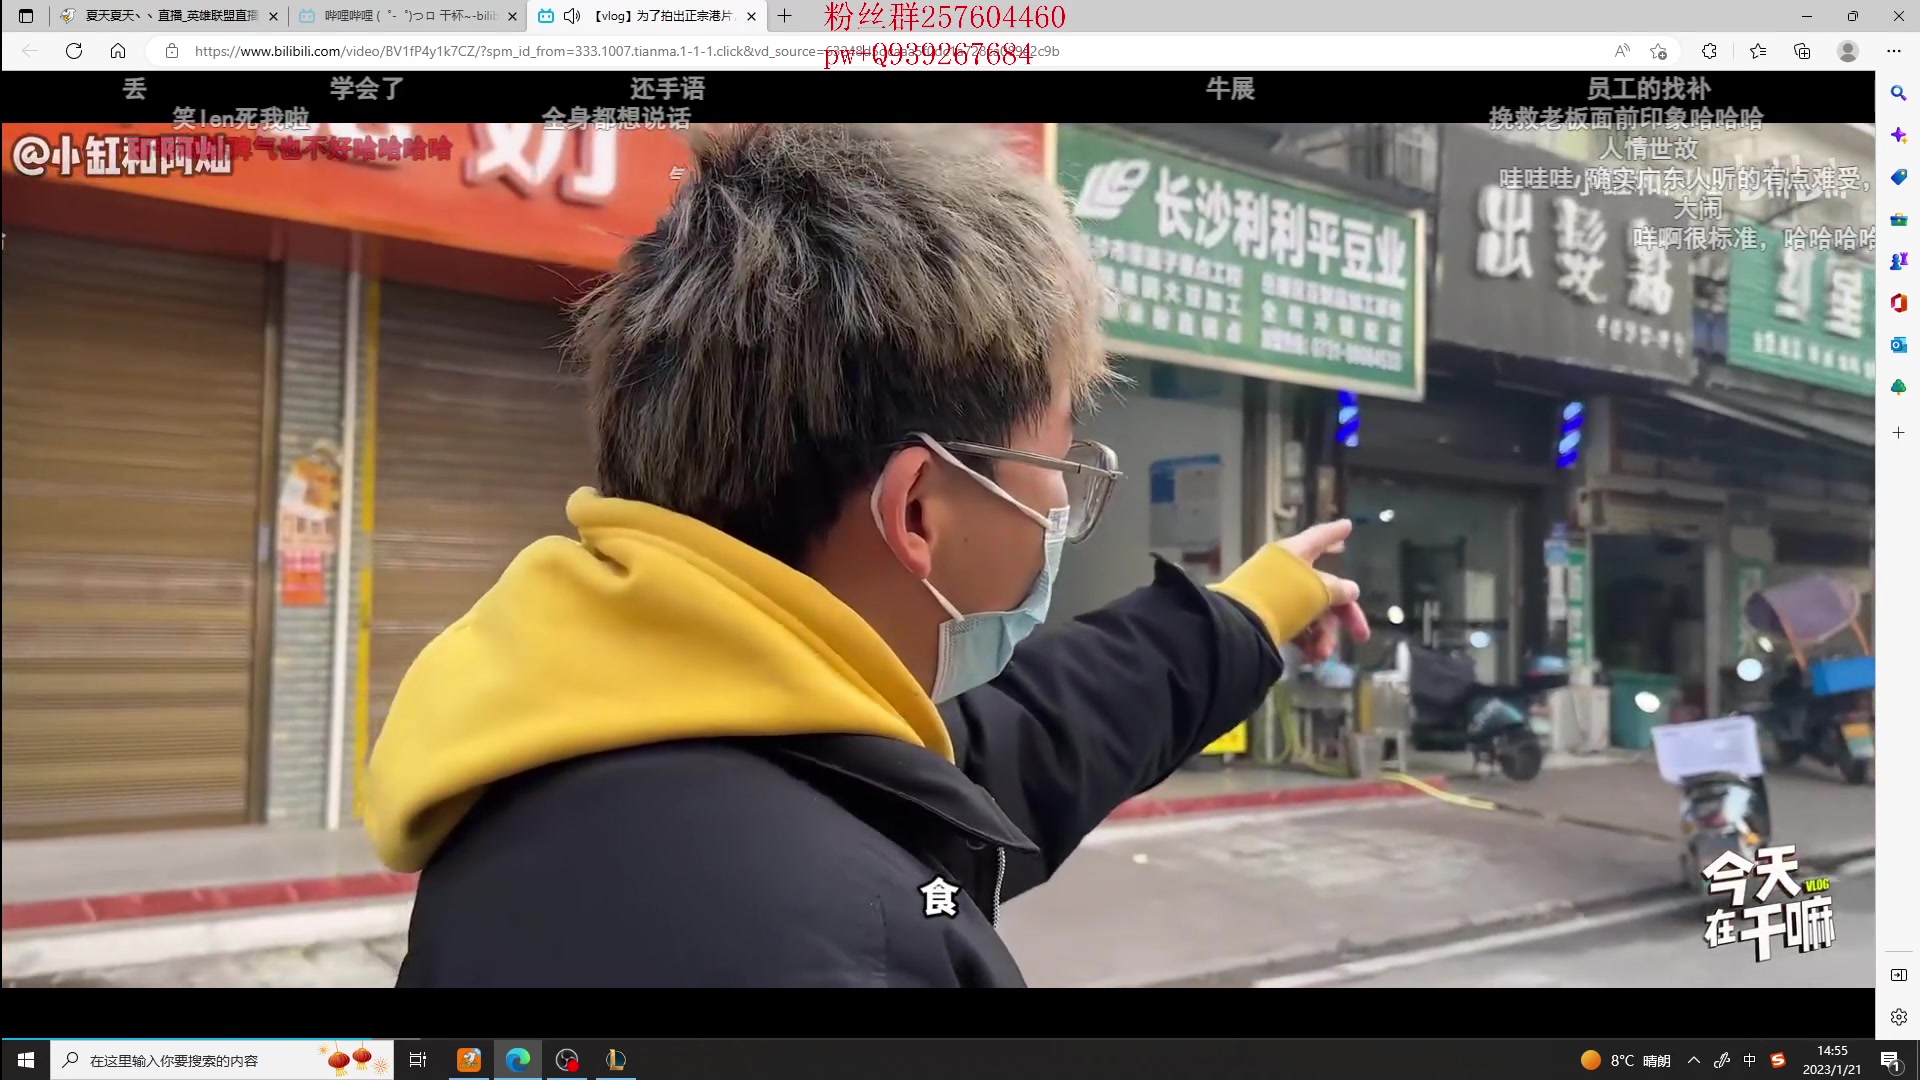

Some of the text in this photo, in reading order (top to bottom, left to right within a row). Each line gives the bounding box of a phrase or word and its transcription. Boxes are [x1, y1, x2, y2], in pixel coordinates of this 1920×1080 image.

[325, 9, 374, 22] 哔哩哔哩
[1154, 165, 1407, 290] 长沙利利平豆业
[1817, 1045, 1849, 1056] 14:55
[90, 1054, 259, 1068] 在这里输入你要搜索的内容
[1643, 1054, 1671, 1068] 晴朗
[1743, 1053, 1756, 1068] 中
[1803, 1064, 1862, 1077] 2023/1/21
